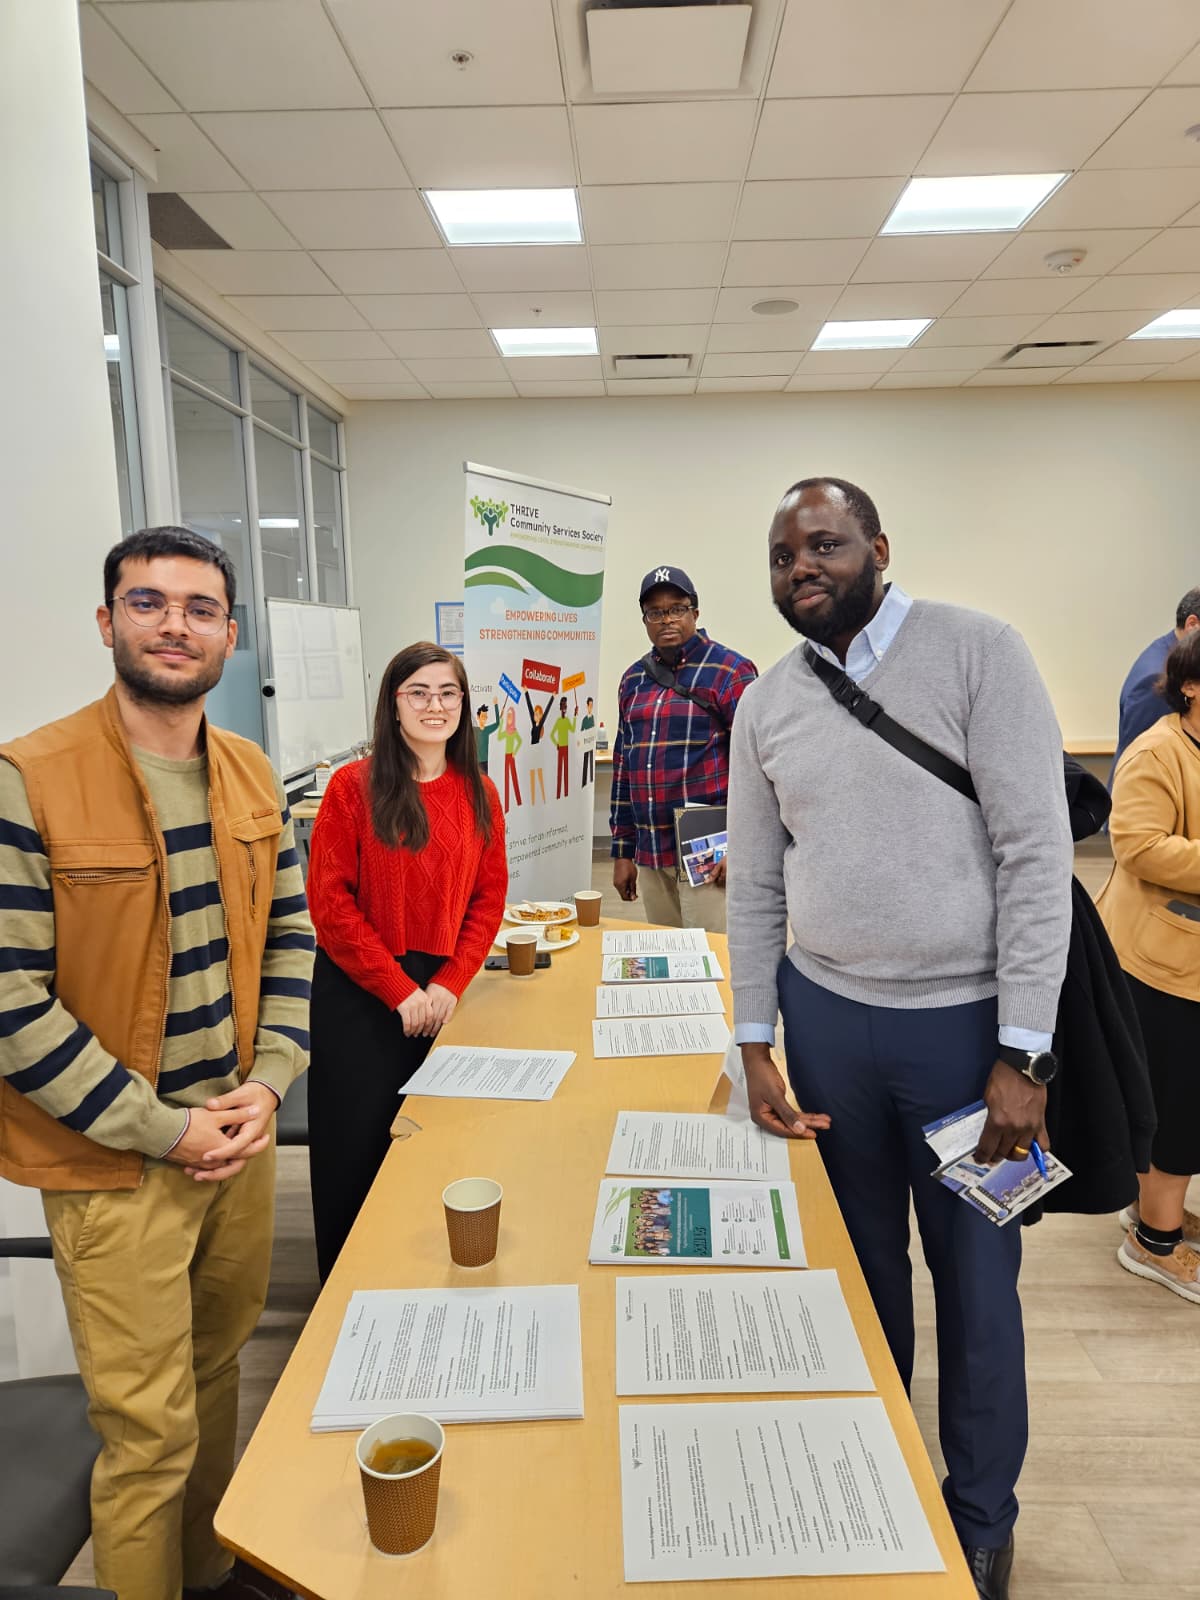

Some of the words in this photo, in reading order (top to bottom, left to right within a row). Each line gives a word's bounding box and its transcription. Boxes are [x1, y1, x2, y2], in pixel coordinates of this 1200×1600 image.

[510, 503, 540, 519] THRIVE
[510, 517, 551, 536] Community
[552, 525, 581, 539] Services
[581, 530, 604, 545] Society
[654, 567, 670, 582] NY
[505, 610, 556, 622] EMPOWERING
[557, 612, 578, 623] LIVES
[479, 628, 546, 640] STRENGTHENING
[546, 630, 596, 641] COMMUNITIES
[524, 667, 556, 684] Collaborate
